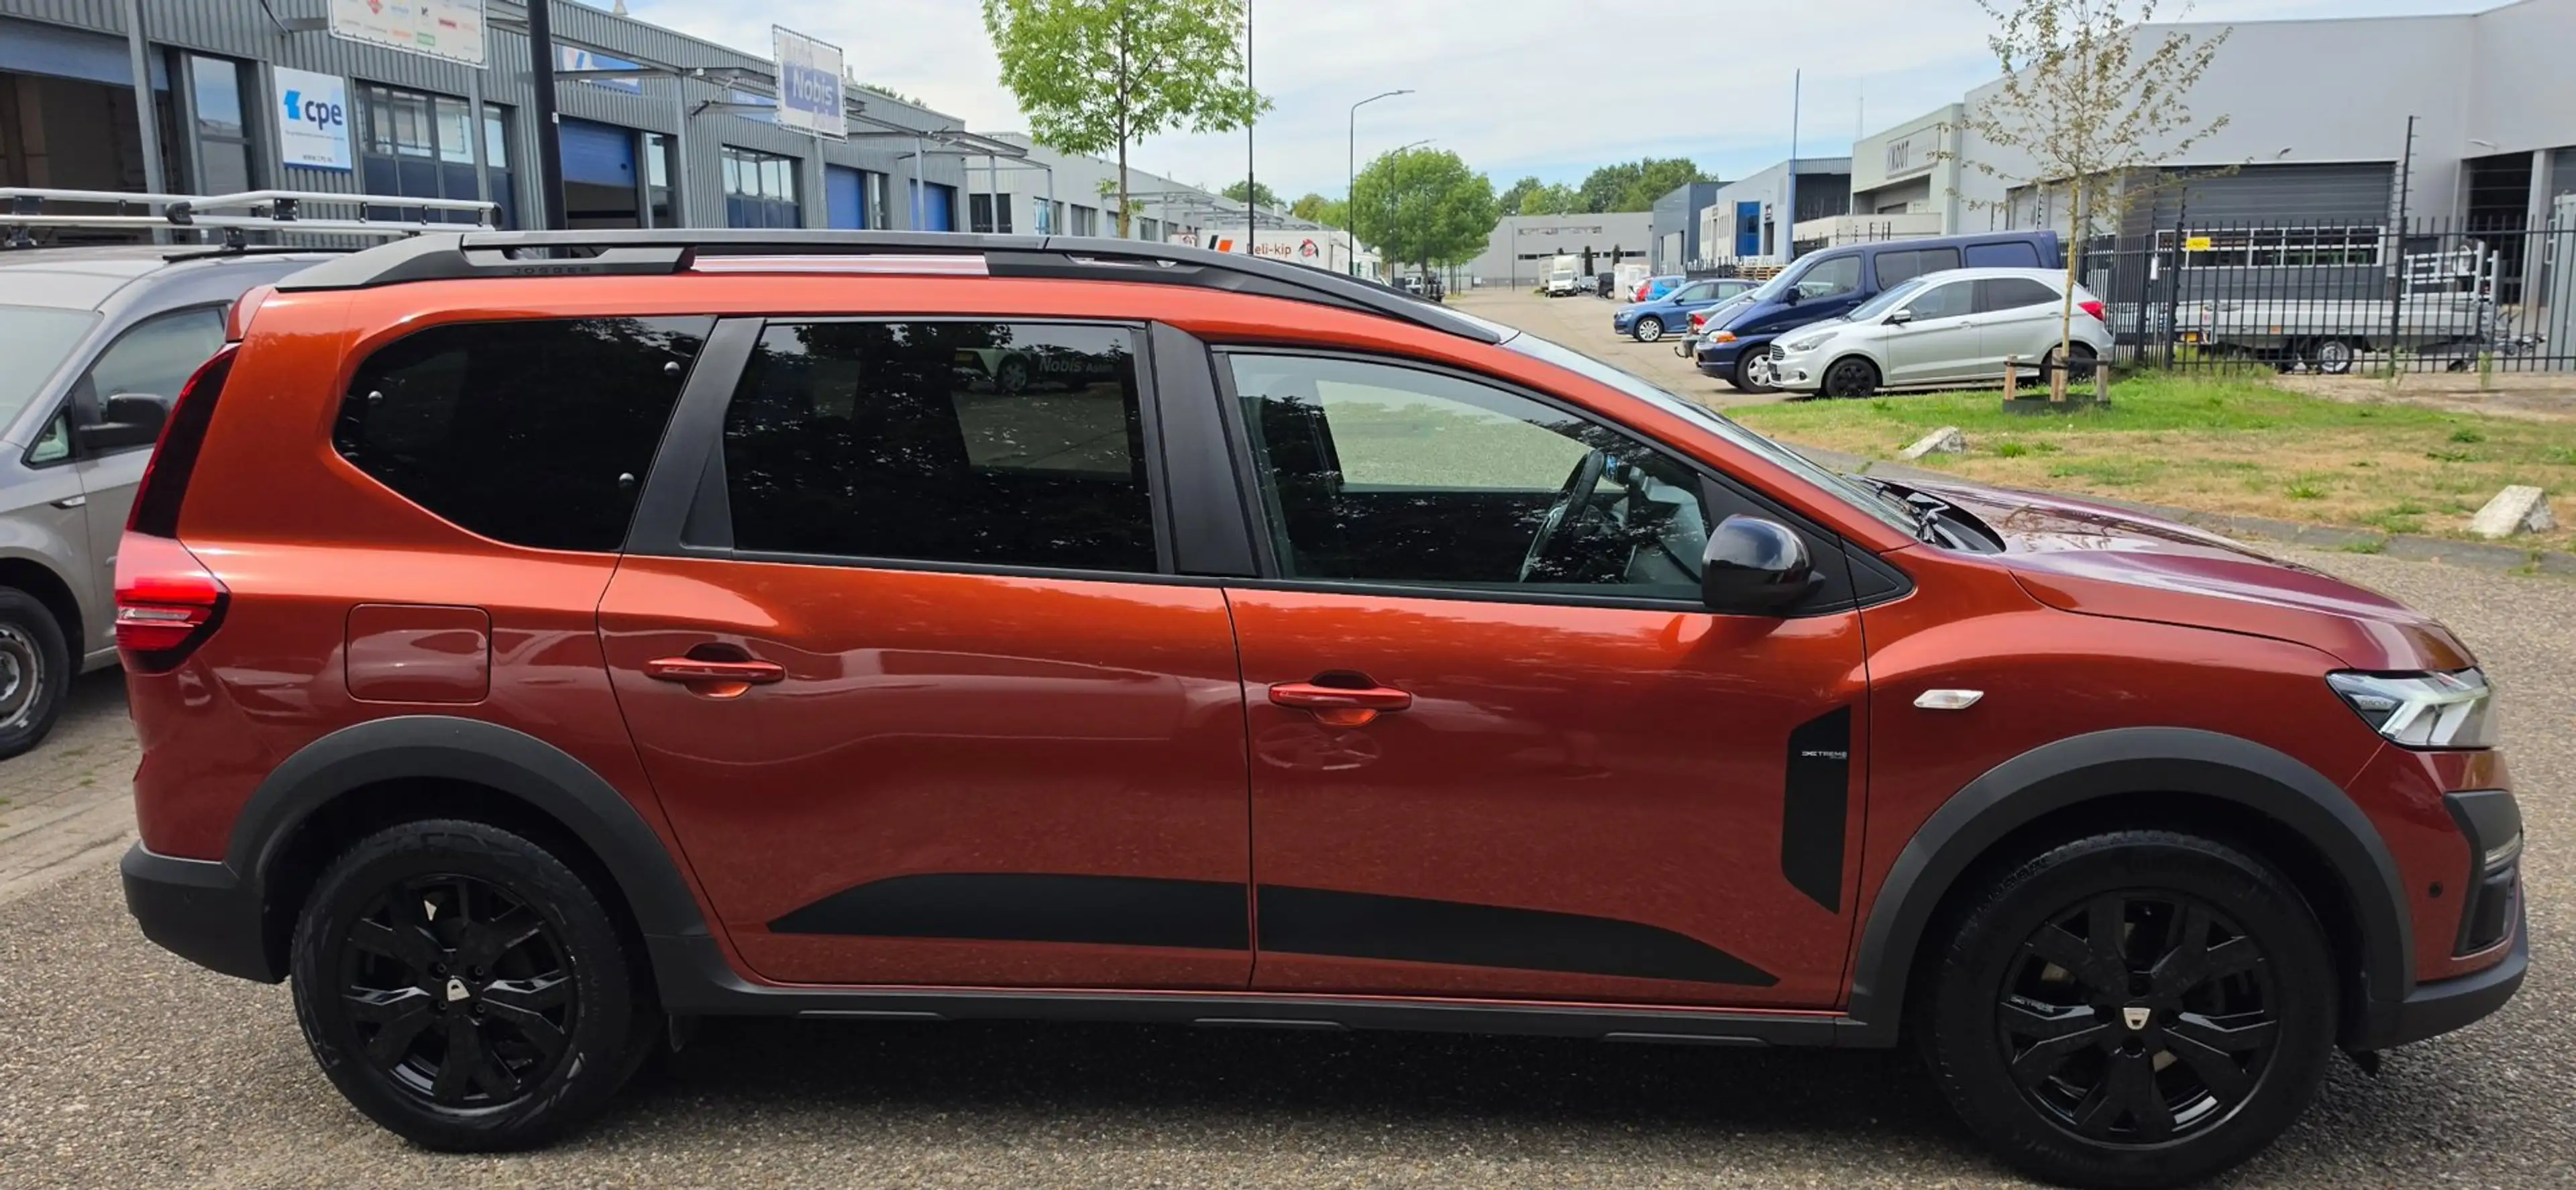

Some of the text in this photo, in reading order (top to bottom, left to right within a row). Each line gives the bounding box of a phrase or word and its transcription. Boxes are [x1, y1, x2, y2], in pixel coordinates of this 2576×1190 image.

[793, 68, 833, 106] Nobis
[305, 101, 343, 131] cpe
[1038, 356, 1082, 373] Nobis
